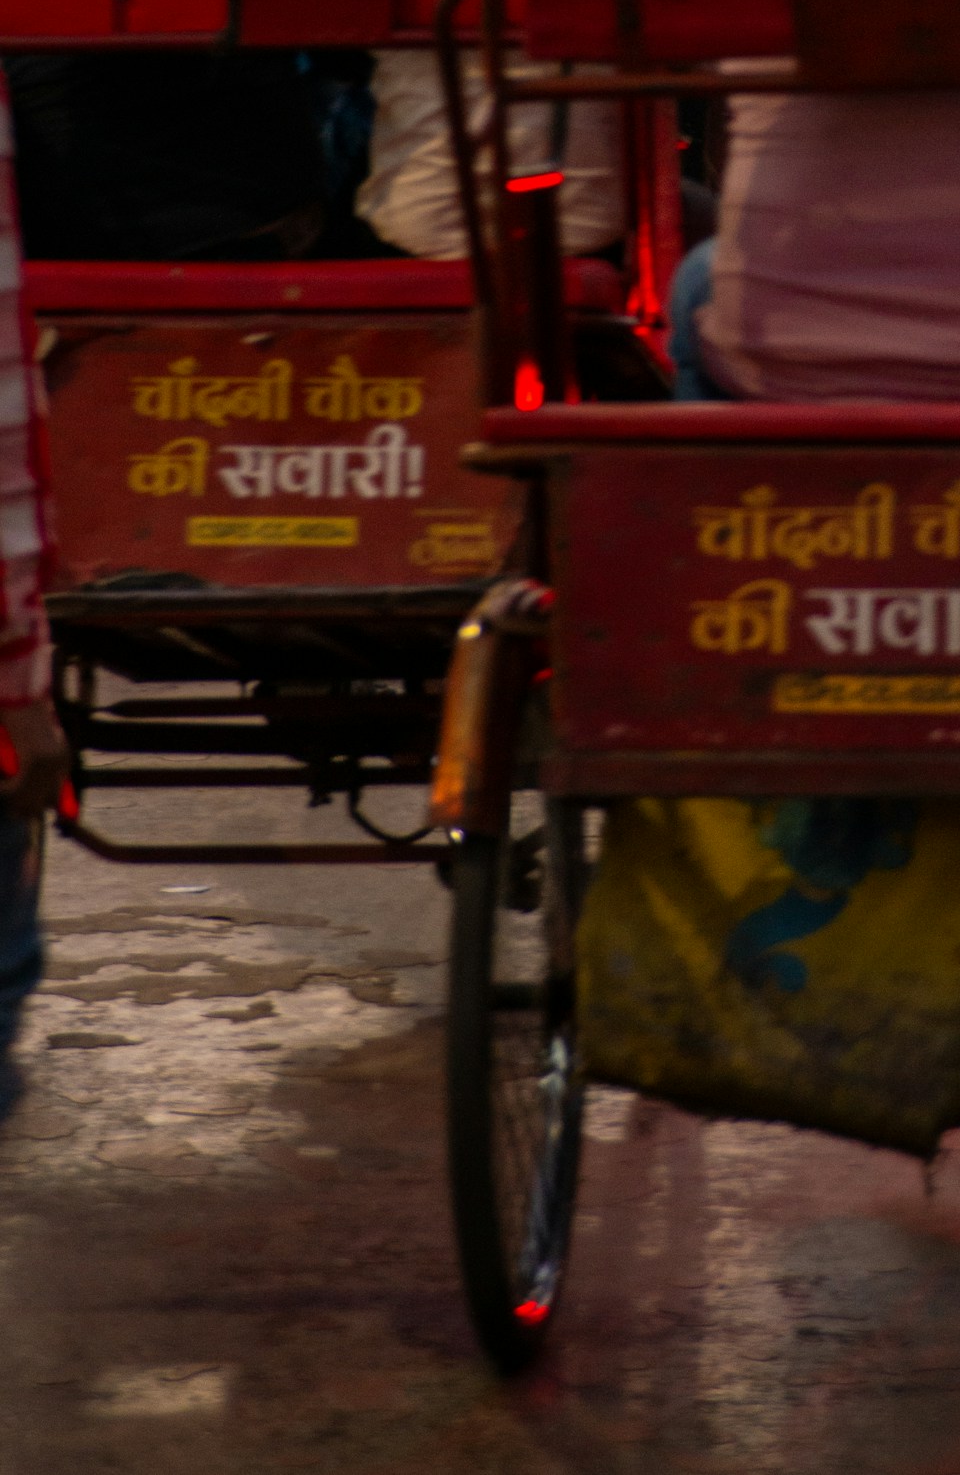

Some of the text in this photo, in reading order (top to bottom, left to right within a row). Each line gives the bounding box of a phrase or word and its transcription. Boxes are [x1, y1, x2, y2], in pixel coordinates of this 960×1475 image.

[305, 355, 425, 421] चौक
[127, 423, 425, 499] की सवारी!
[690, 577, 791, 656] की
